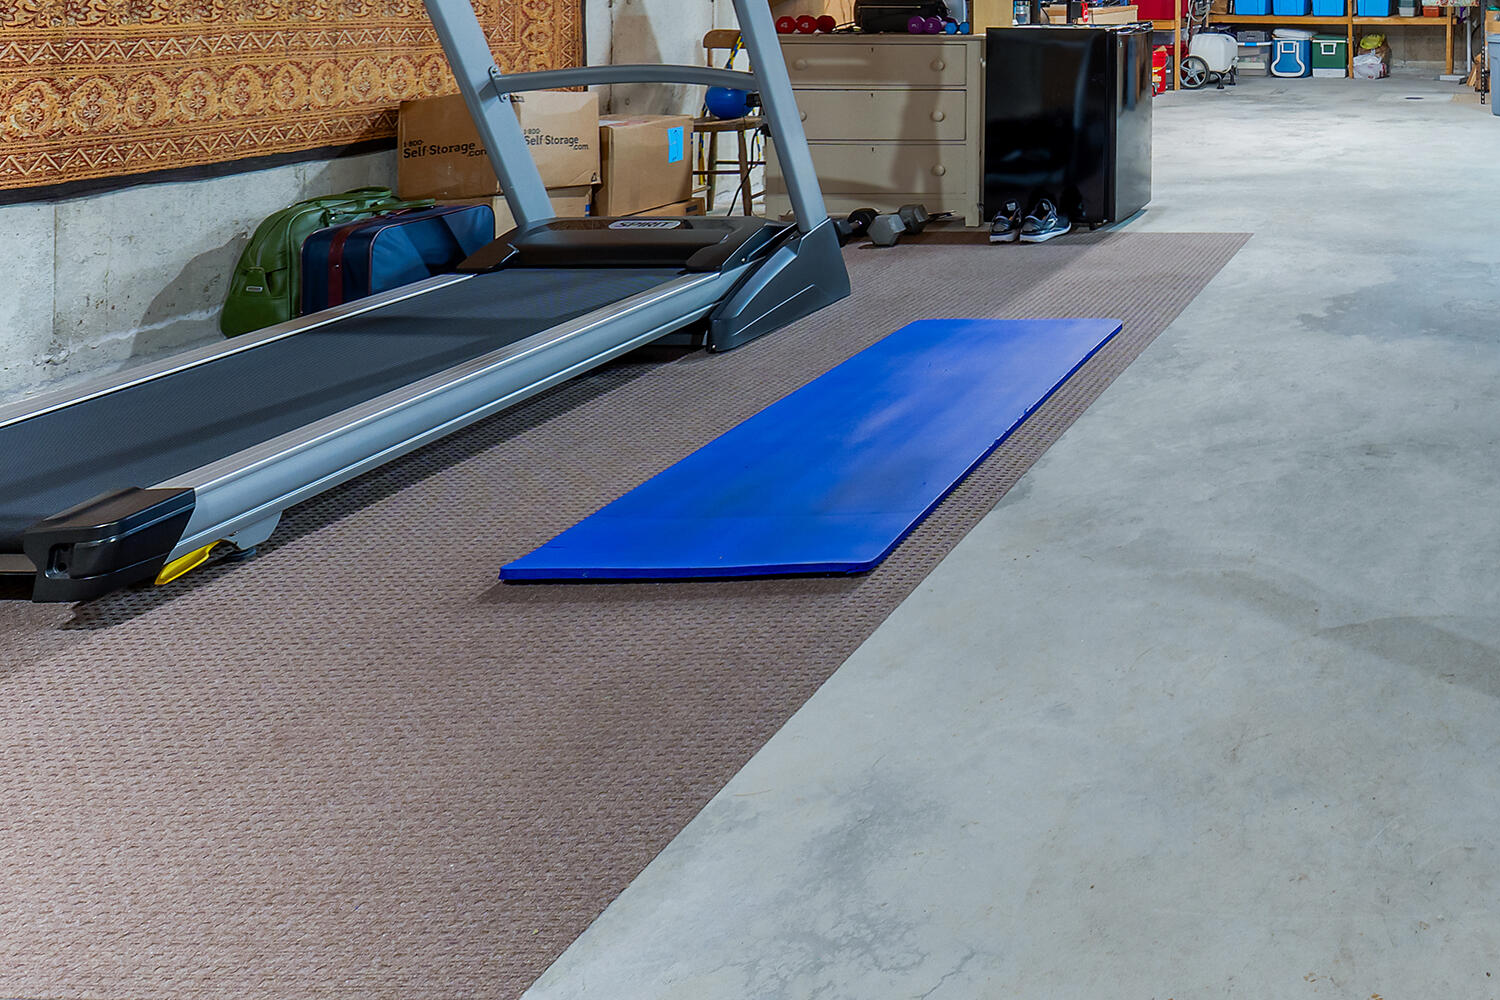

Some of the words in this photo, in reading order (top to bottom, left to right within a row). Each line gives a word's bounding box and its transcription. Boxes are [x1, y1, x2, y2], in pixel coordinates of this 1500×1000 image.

[524, 135, 544, 146] Self
[544, 134, 579, 147] Storage
[573, 143, 589, 151] .com
[403, 145, 427, 159] Self
[429, 142, 476, 156] Storage
